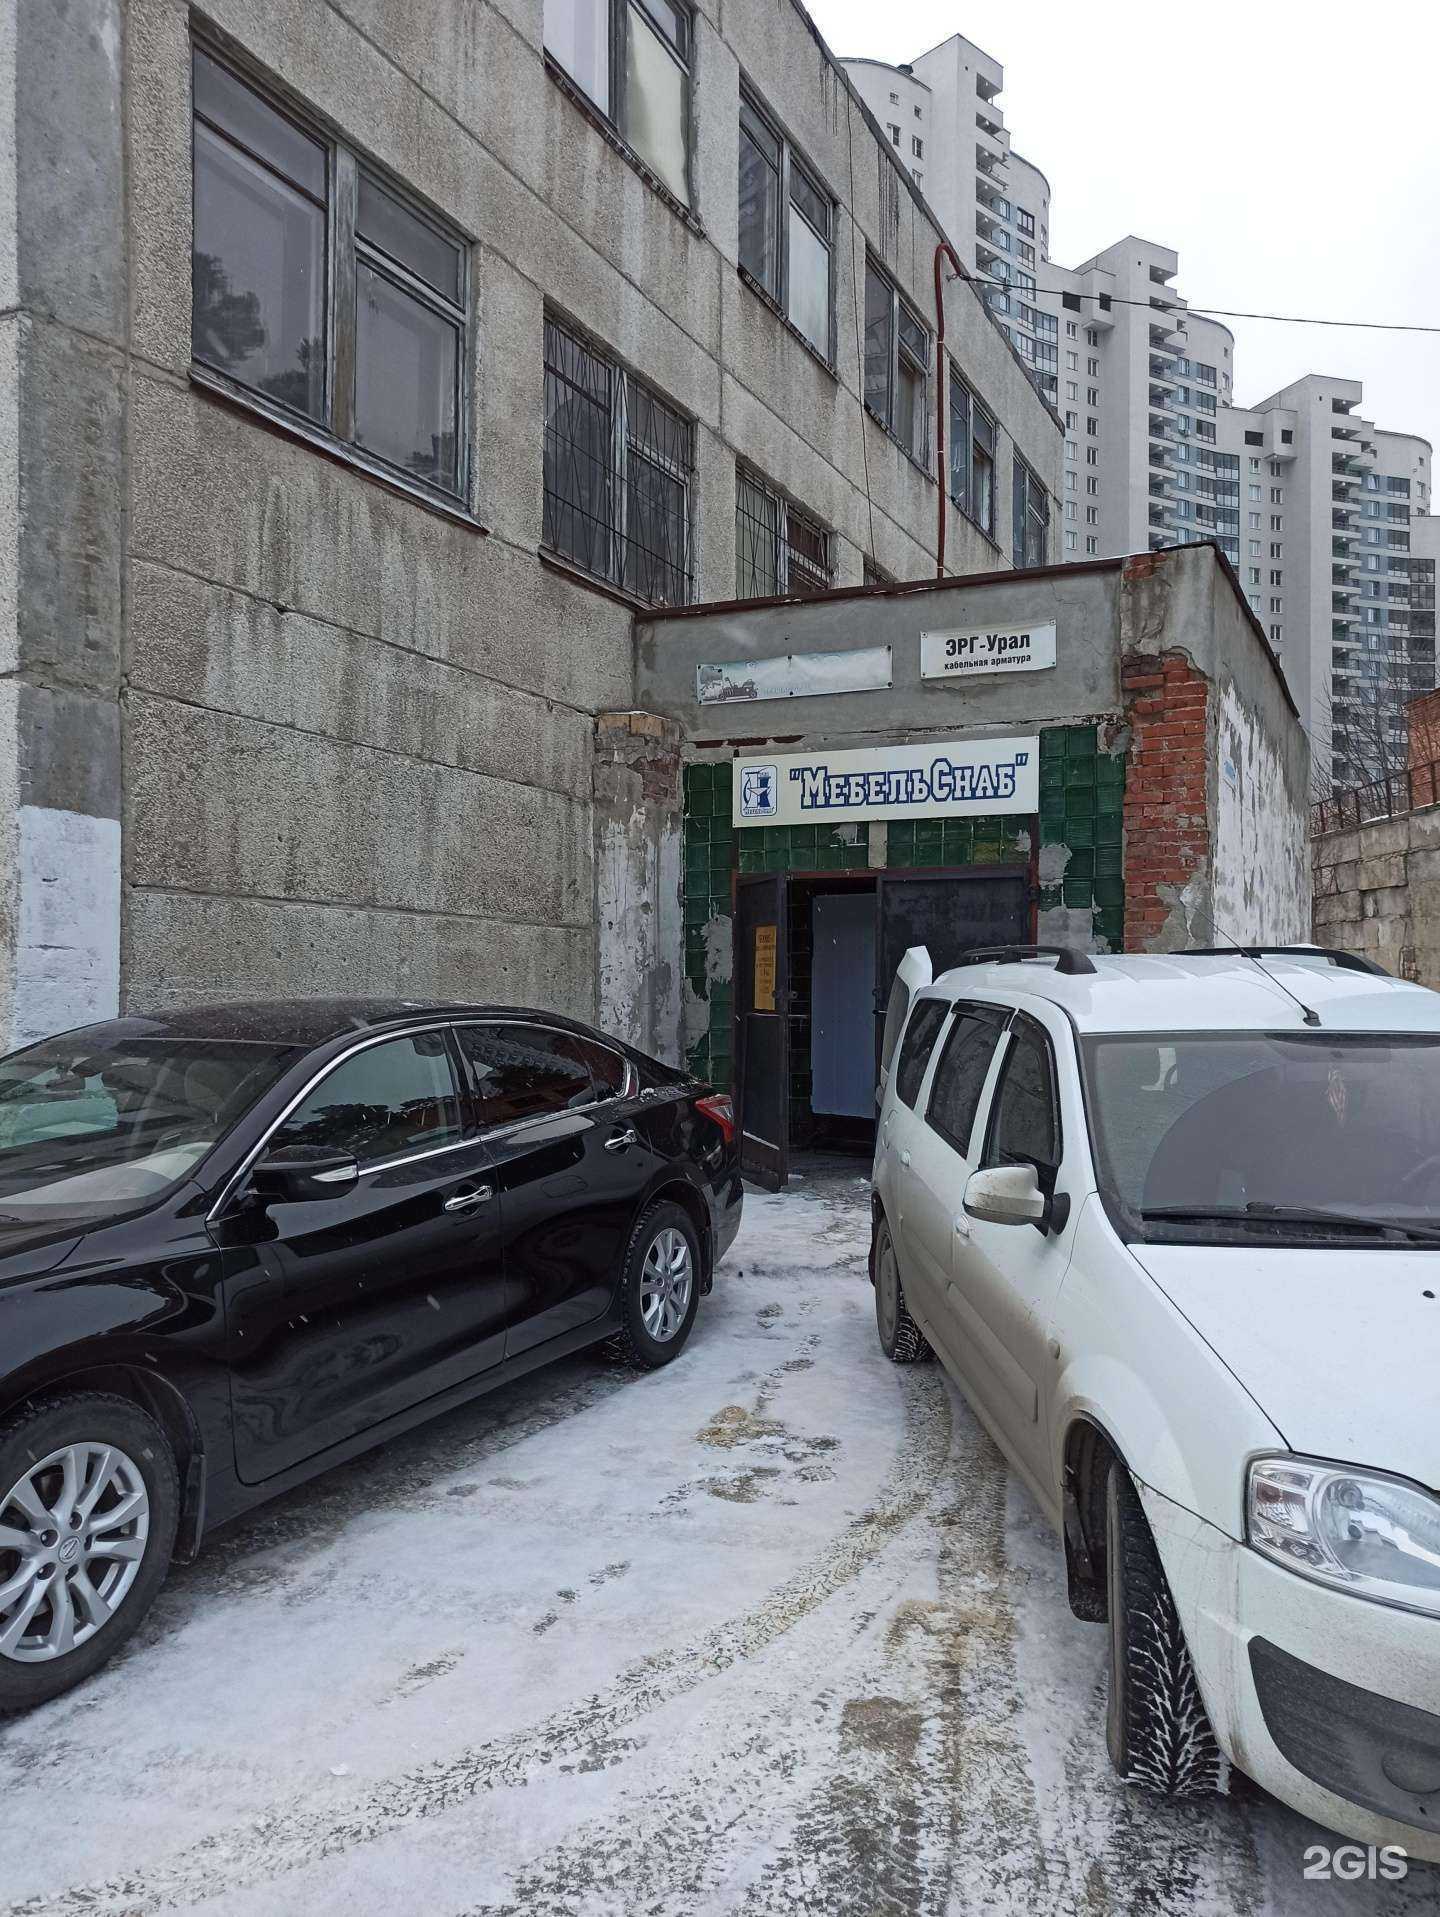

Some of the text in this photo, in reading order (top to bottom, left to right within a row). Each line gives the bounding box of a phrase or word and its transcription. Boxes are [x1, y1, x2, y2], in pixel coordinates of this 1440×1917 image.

[945, 633, 1031, 657] ЭРГ-Урал
[944, 654, 1032, 670] кабельная арматура
